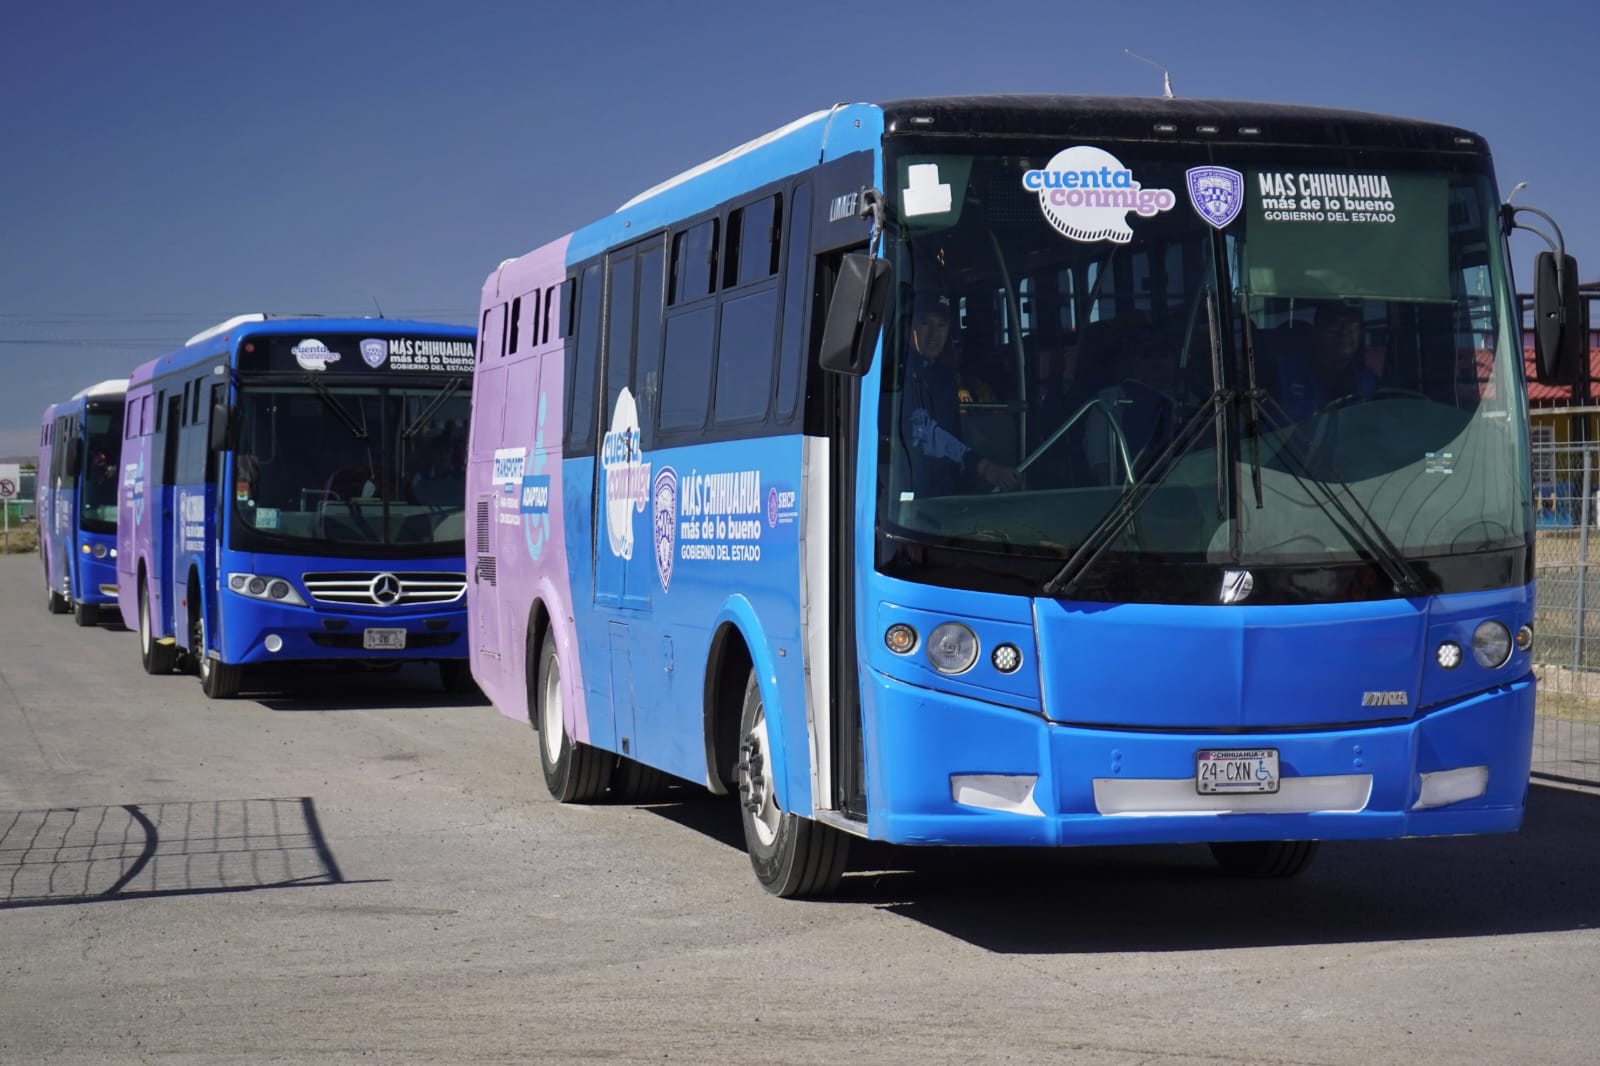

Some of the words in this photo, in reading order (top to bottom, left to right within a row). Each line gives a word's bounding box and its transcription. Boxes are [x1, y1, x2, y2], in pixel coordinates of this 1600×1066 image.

[1025, 166, 1131, 188] cuenta
[1299, 173, 1392, 198] CHIHUAHUA
[1050, 189, 1171, 214] conmigo
[1262, 195, 1297, 209] más
[1300, 196, 1321, 209] de
[1325, 197, 1340, 210] lo
[1345, 198, 1395, 211] bueno
[1264, 211, 1325, 221] GOBIERNO
[1327, 212, 1350, 221] DEL
[1352, 213, 1396, 223] ESTADO
[292, 346, 327, 354] cuenta
[390, 338, 413, 355] MÁS
[415, 340, 474, 357] CHIHUAHUA
[390, 354, 412, 362] más
[414, 355, 428, 363] de
[430, 355, 441, 363] lo
[442, 356, 475, 365] bueno
[681, 469, 702, 516] MÁS
[704, 470, 760, 515] CHIHUAHUA
[681, 515, 700, 539] más
[702, 516, 714, 540] de
[716, 515, 726, 540] lo
[728, 515, 761, 540] bueno
[681, 544, 715, 560] GOBIERNO
[717, 545, 730, 560] DEL
[732, 545, 760, 561] ESTADO
[1202, 762, 1251, 781] 24-CXN
